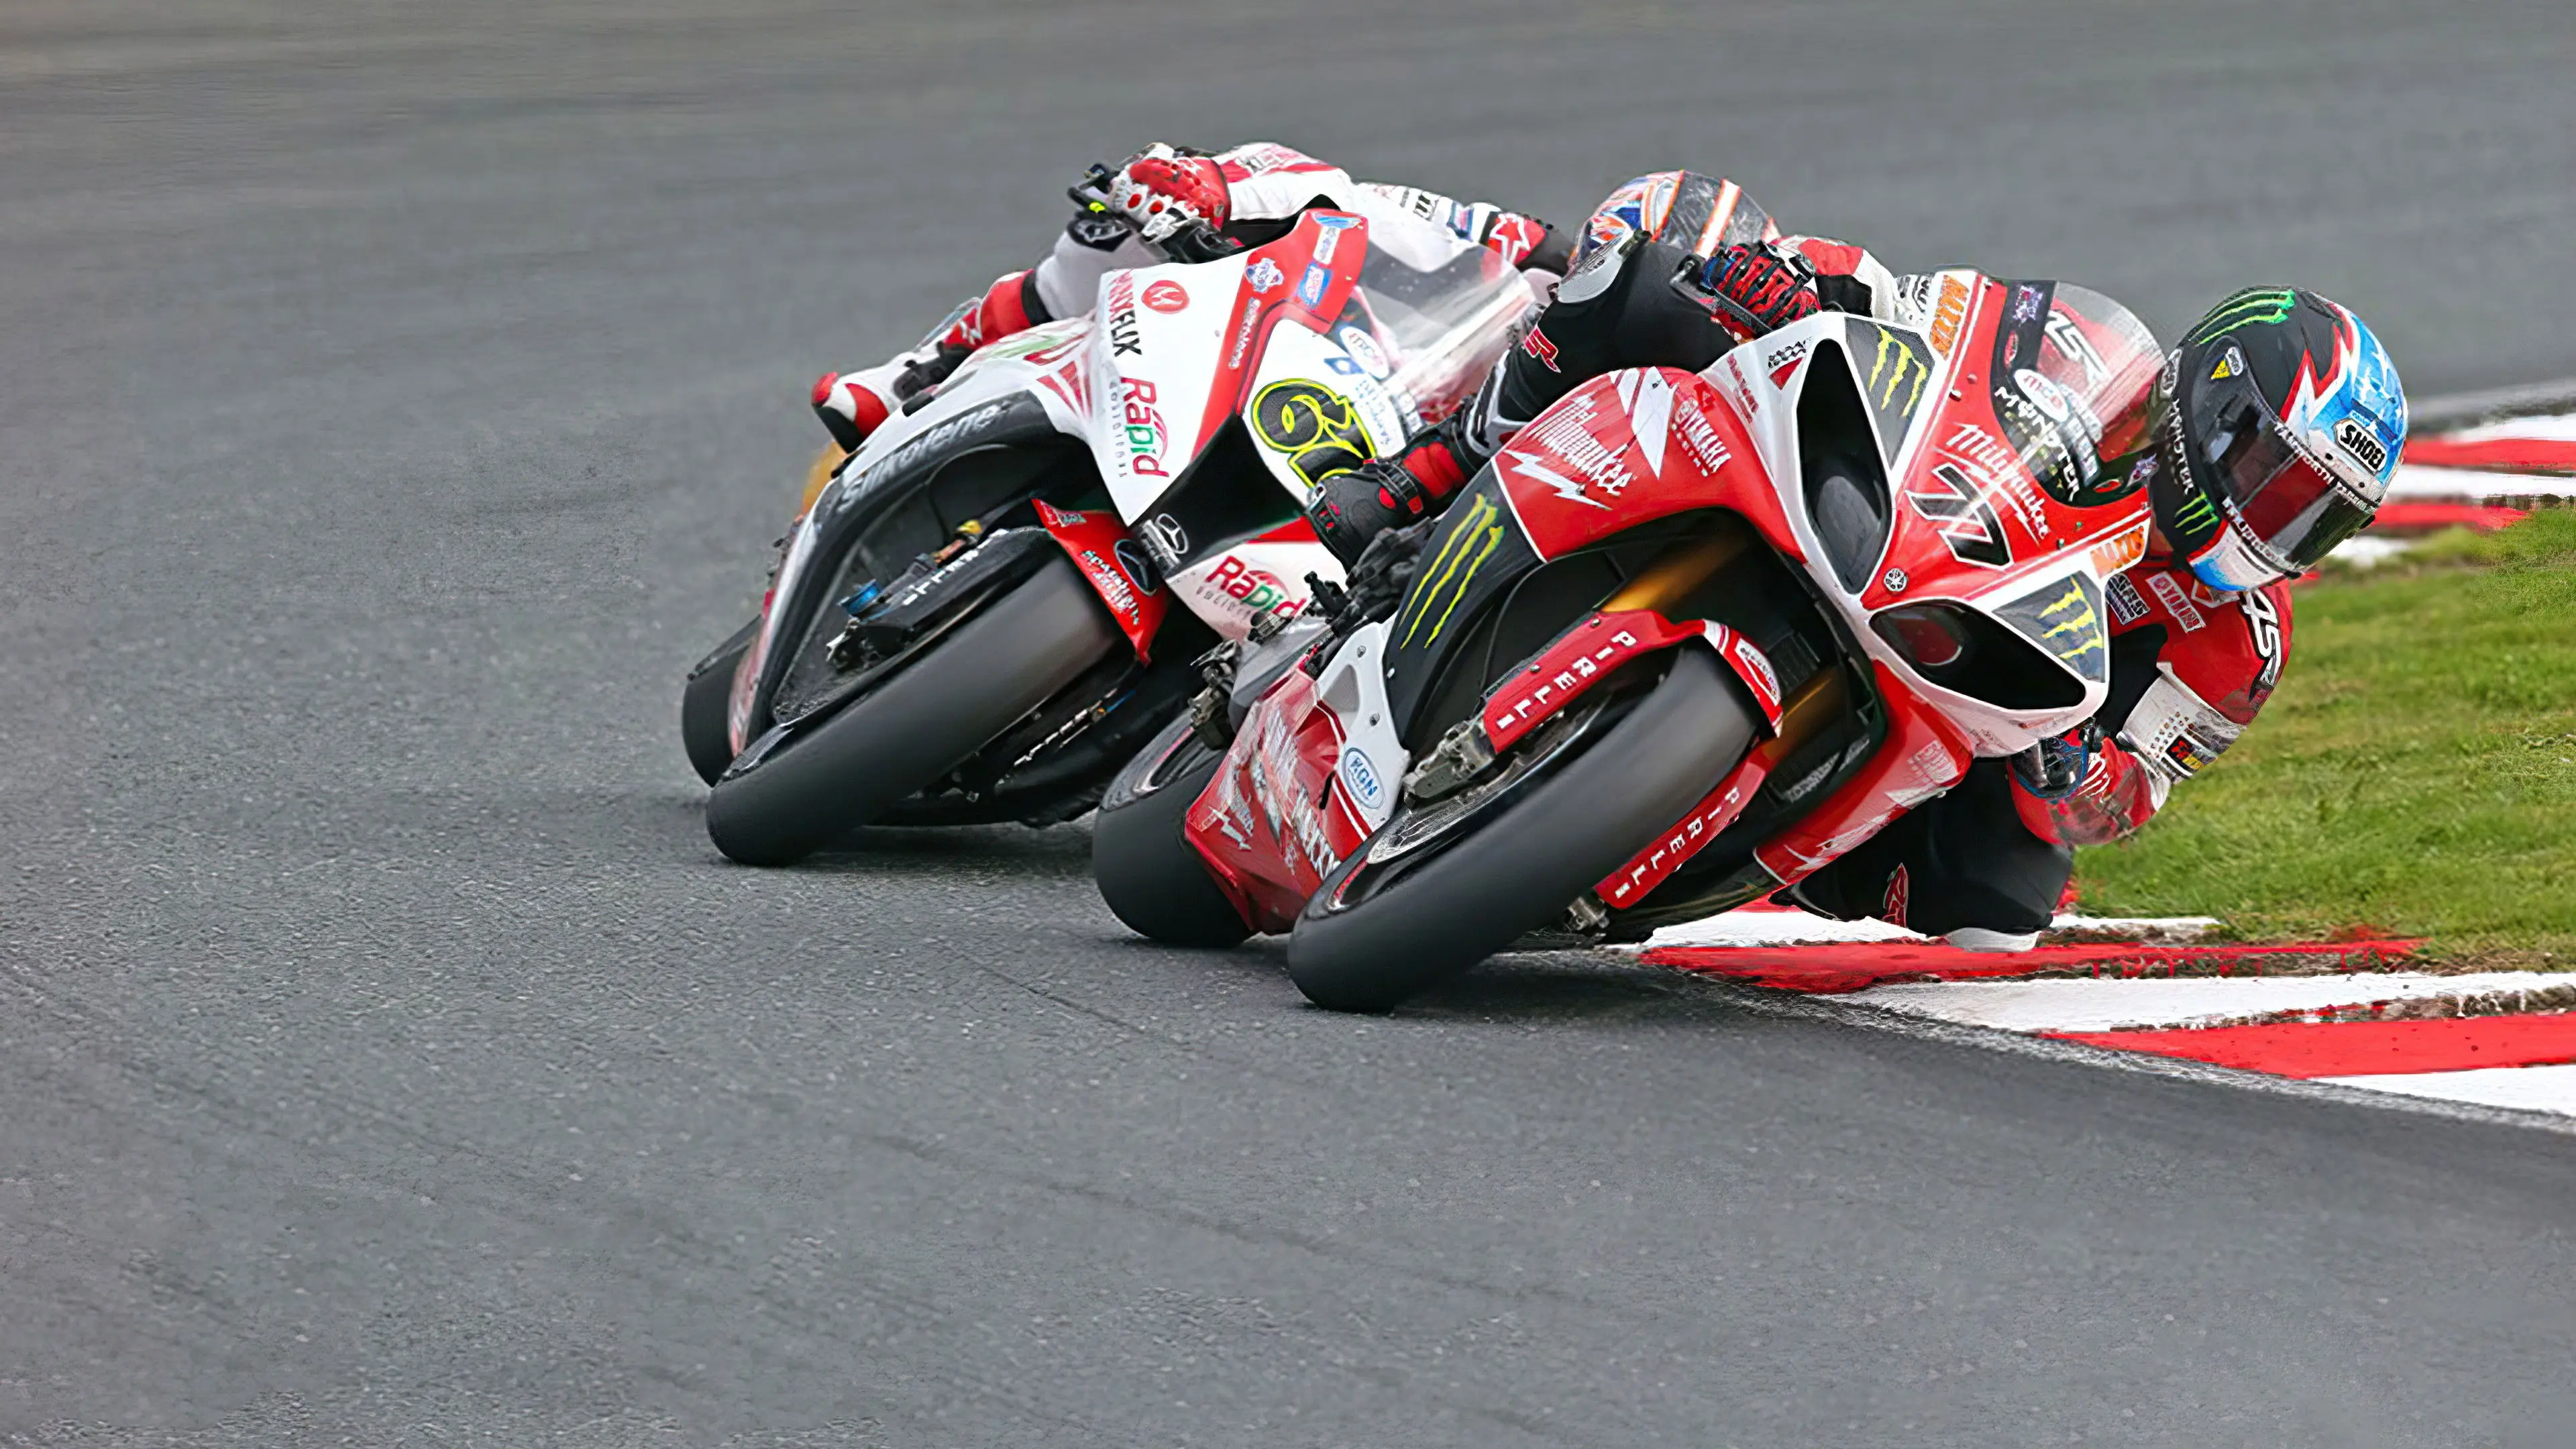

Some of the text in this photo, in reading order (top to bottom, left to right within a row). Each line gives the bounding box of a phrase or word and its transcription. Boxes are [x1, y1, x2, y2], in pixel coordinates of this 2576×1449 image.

[1119, 376, 1170, 478] Rapid
[1250, 378, 1377, 489] 67
[1994, 385, 2080, 502] MONSTER
[1205, 555, 1307, 619] Rapid
[1496, 630, 1638, 730] PIRELLI
[1614, 786, 1741, 900] PIRELLI
